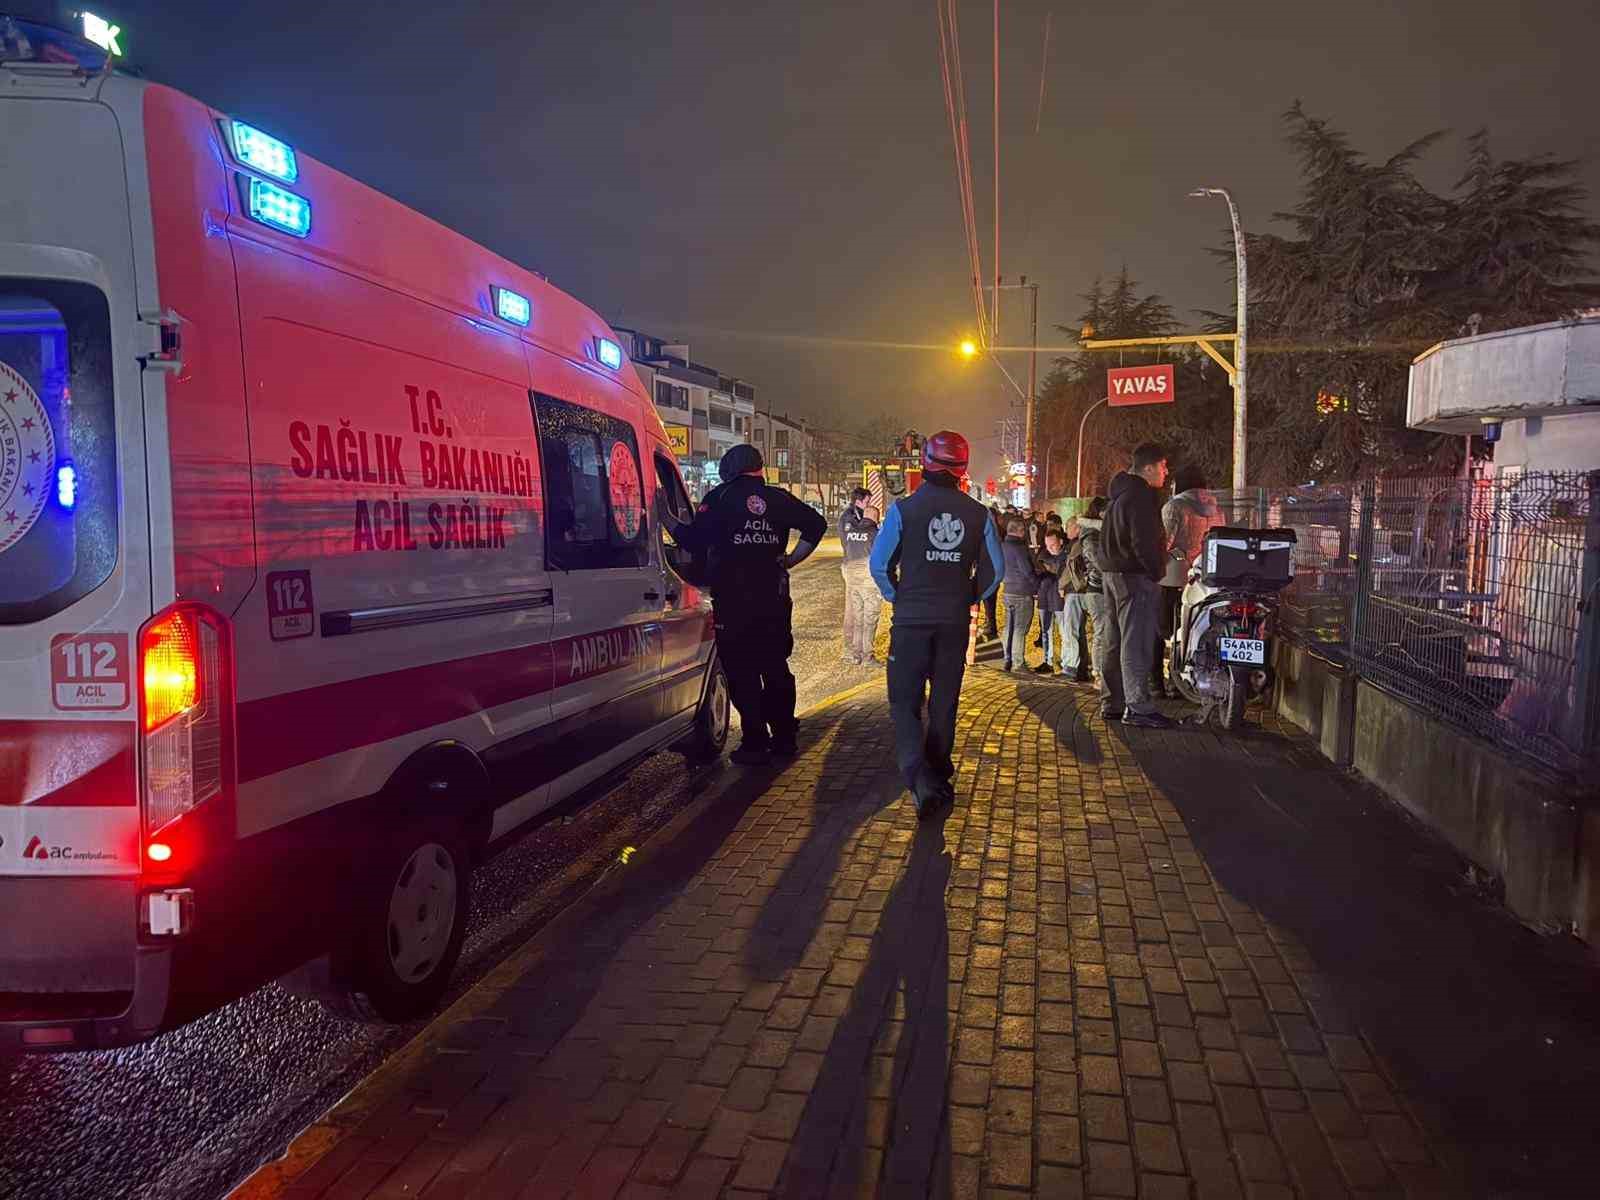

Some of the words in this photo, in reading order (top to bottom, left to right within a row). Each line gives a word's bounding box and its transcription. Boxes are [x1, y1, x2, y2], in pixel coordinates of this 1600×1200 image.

[1113, 375, 1167, 394] YAVAŞ
[404, 384, 453, 438] T.C.
[288, 416, 407, 486] SAĞLIK
[419, 439, 533, 497] BAKANLIĞI
[352, 492, 417, 551] ACİL
[427, 497, 506, 550] SAĞLIK
[926, 550, 961, 562] UMKE
[272, 578, 307, 611] 112
[62, 641, 118, 678] 112
[1231, 650, 1254, 662] 402
